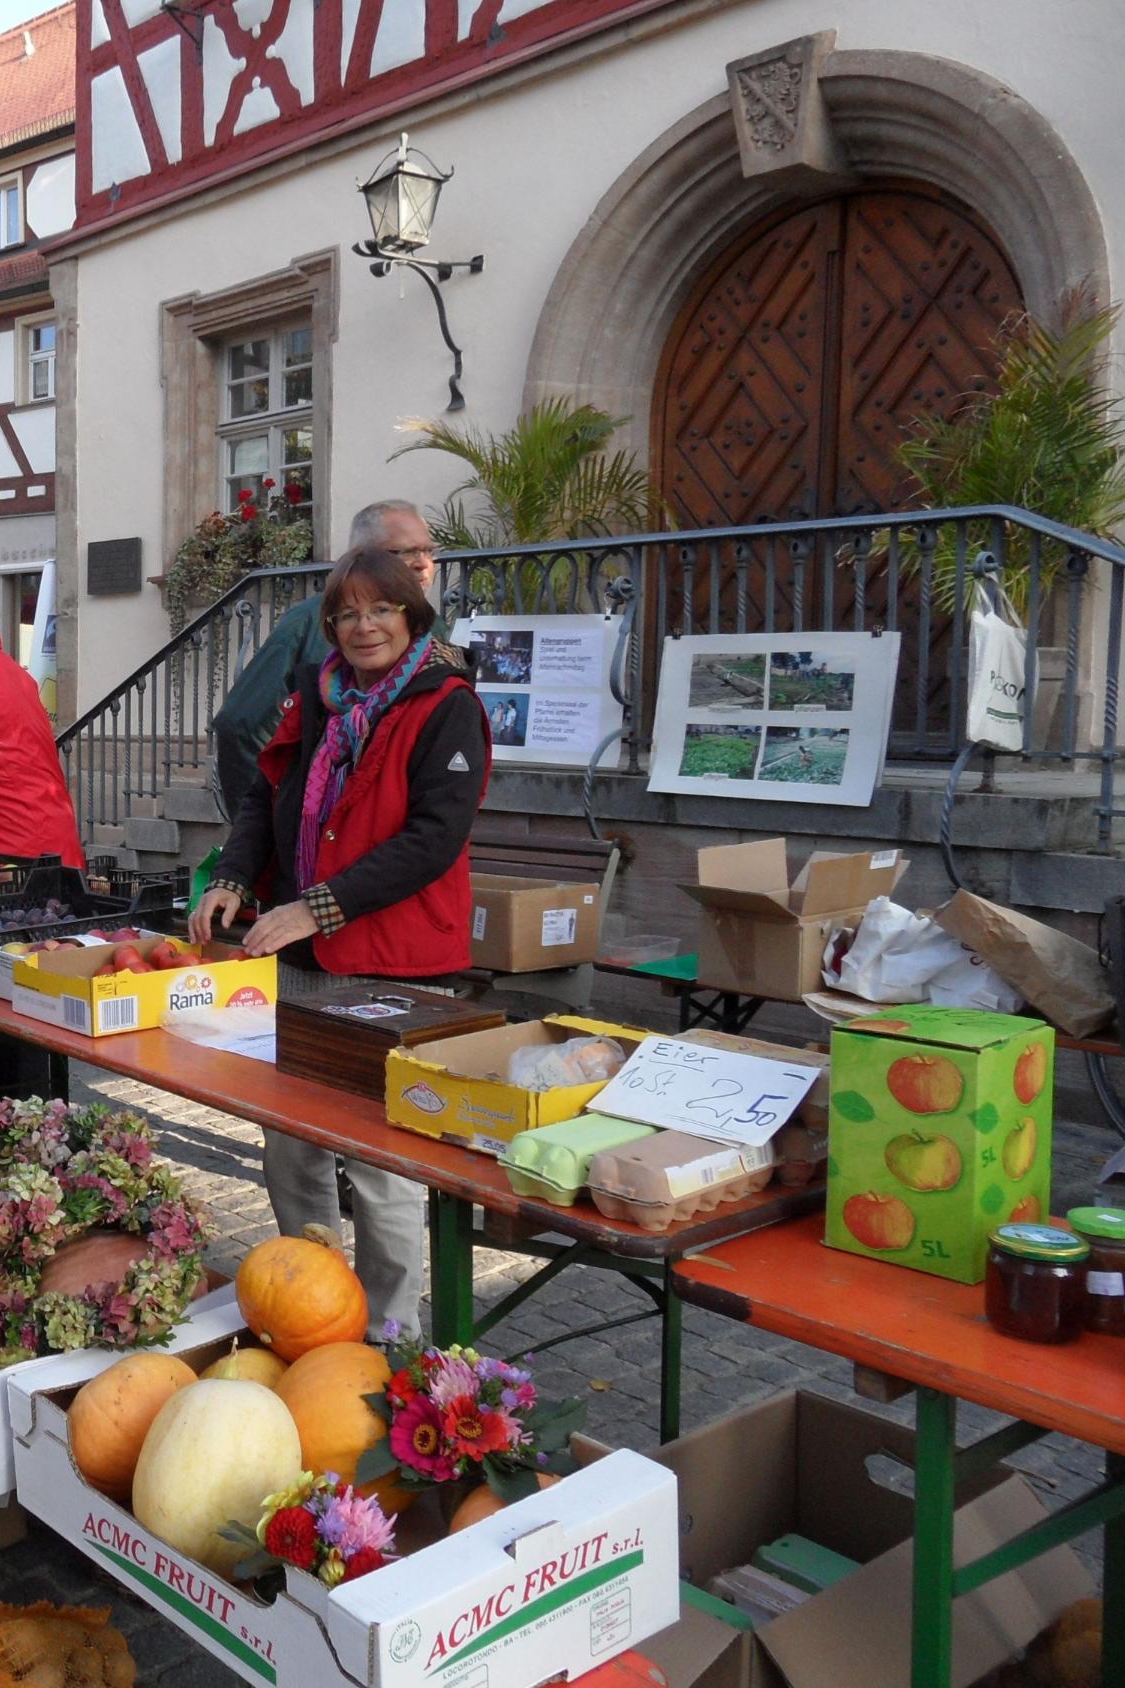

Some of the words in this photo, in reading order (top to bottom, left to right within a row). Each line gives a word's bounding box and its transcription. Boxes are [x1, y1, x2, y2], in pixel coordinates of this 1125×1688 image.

[170, 991, 213, 1011] Rama
[239, 992, 254, 1000] Jetzt
[652, 1042, 719, 1064] Eier
[619, 1066, 644, 1089] 10
[920, 1238, 952, 1259] 5L
[82, 1512, 147, 1566] ACMC
[153, 1550, 236, 1625] FRUIT
[423, 1585, 515, 1672] ACMC
[521, 1532, 609, 1604] FRUIT
[611, 1528, 644, 1555] s.r.l.
